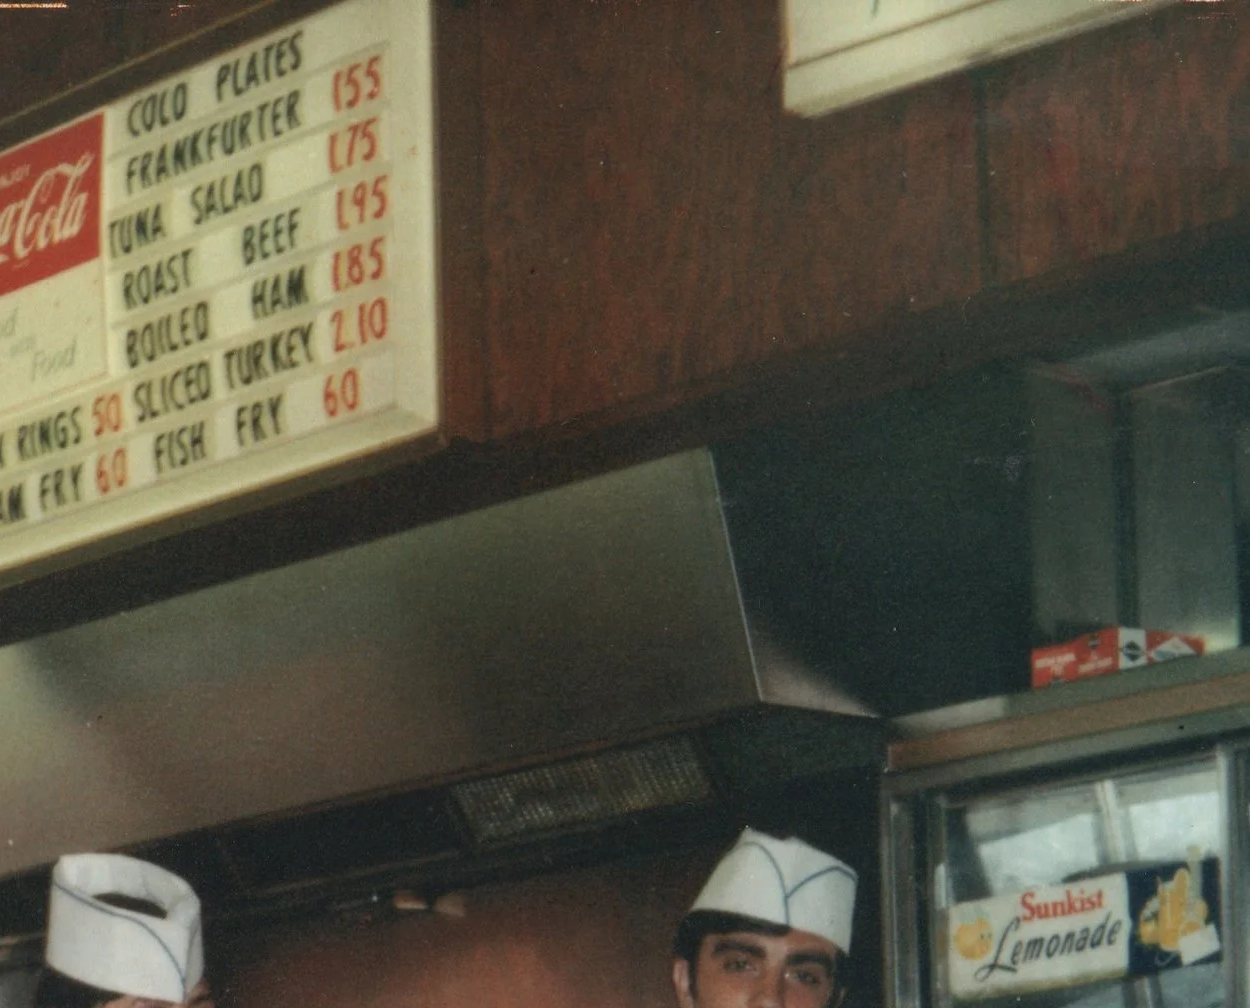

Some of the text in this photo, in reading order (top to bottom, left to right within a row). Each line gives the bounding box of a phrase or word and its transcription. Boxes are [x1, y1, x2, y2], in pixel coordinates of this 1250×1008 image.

[126, 30, 302, 137] COLD PLATES
[126, 89, 301, 195] FRANKFURTER
[108, 202, 166, 259] TUNA
[190, 162, 264, 226] SALAD
[123, 248, 194, 311] ROAST
[242, 206, 301, 266] BEEF
[126, 300, 210, 369] BOILED
[251, 262, 308, 321] HAM
[134, 355, 213, 423] SLICED
[224, 320, 316, 392] TURKEY
[153, 367, 360, 474] FISH FRY 60
[16, 406, 82, 462] RINGS
[91, 393, 123, 438] 50
[39, 464, 83, 511] FRY
[95, 447, 128, 495] 60
[974, 911, 1123, 982] Lemonade
[1020, 888, 1105, 922] Sunkist
